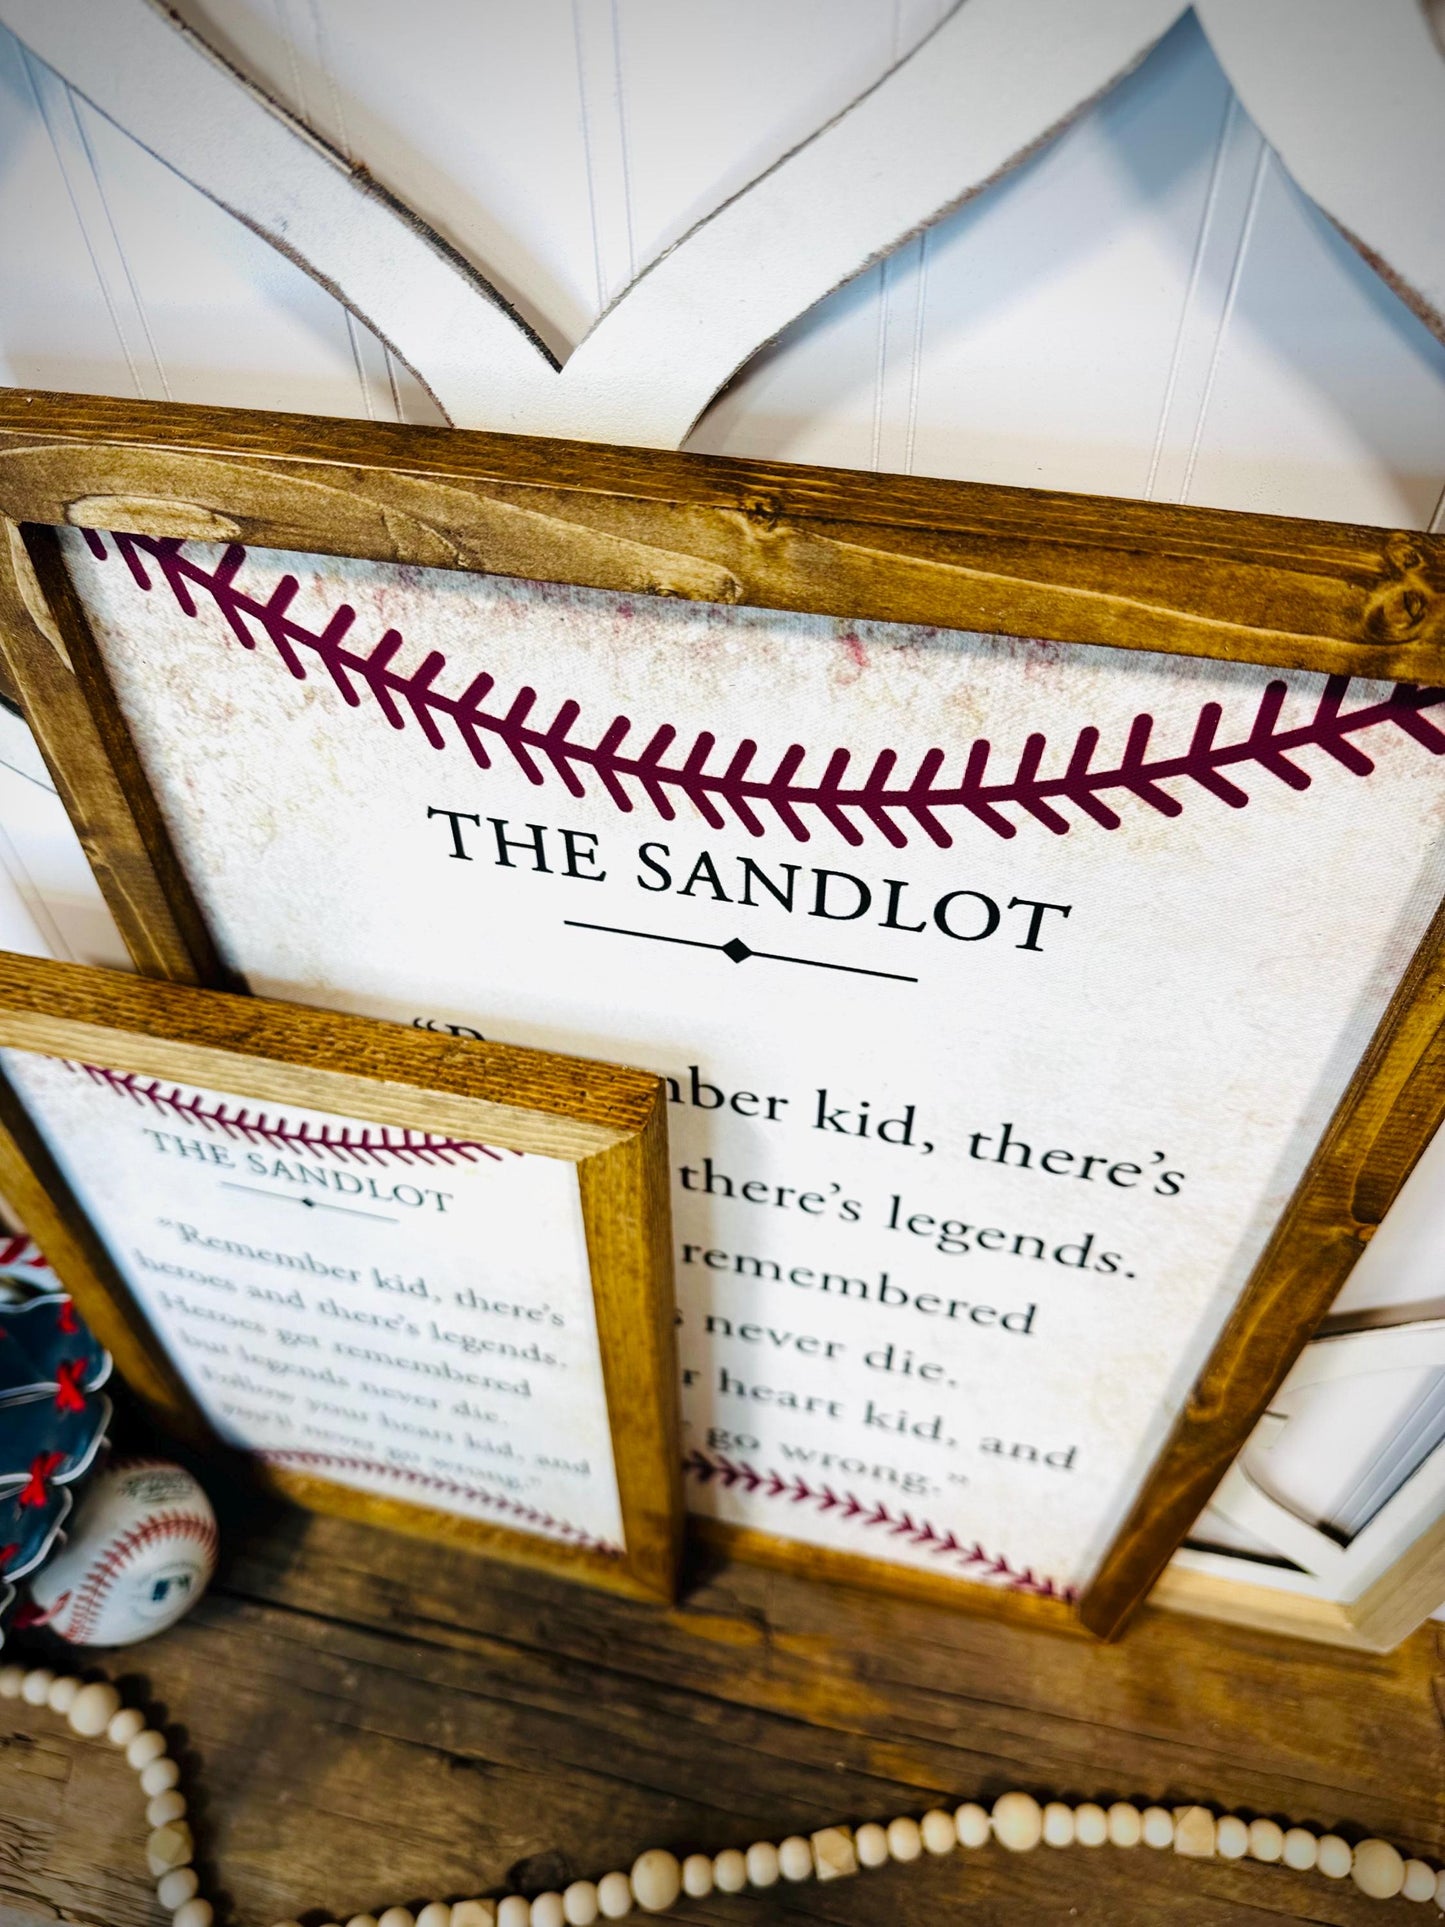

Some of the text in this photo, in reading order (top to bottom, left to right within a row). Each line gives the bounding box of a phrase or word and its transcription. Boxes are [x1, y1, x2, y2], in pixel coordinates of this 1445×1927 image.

[427, 805, 1073, 953] THE SANDLOT
[143, 1126, 454, 1214] THE SANDLOT
[813, 1088, 936, 1155] kid,
[967, 1122, 1187, 1198] there’s
[678, 1157, 1138, 1279] there’s legends.
[246, 1284, 306, 1311] and
[428, 1320, 569, 1370] legends.
[372, 1267, 443, 1304] kid,
[681, 1241, 1039, 1337] remembered
[332, 1341, 533, 1399] remembered
[705, 1313, 959, 1389] never die.
[707, 1426, 761, 1452] go
[719, 1366, 842, 1418] heart
[980, 1432, 1079, 1473] and
